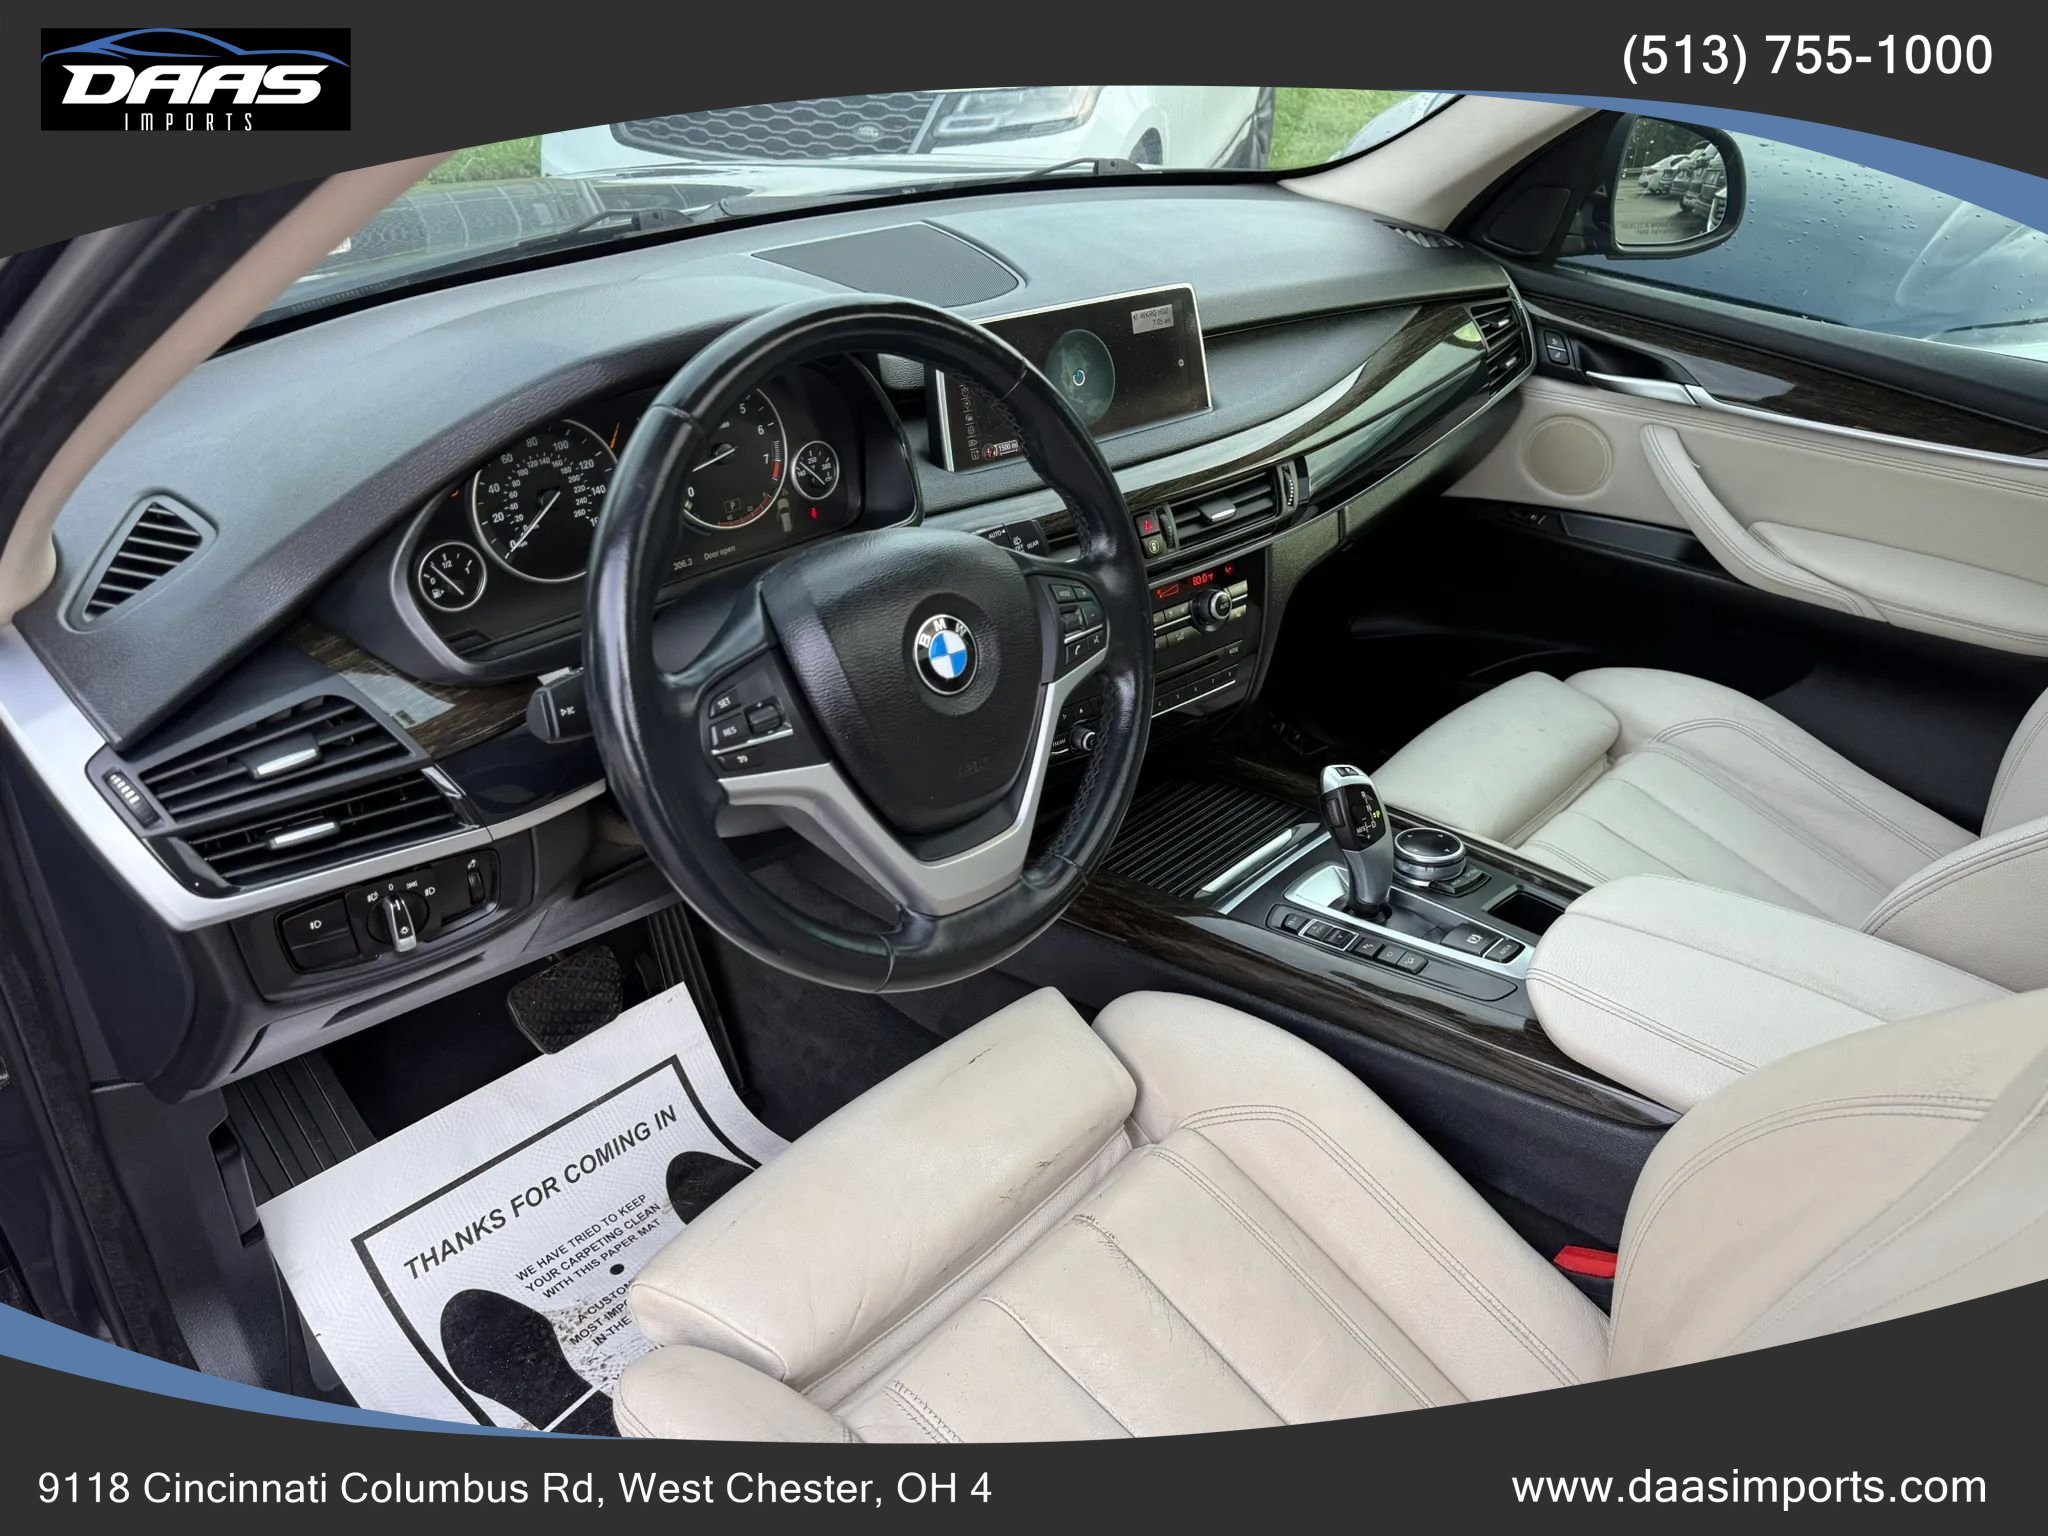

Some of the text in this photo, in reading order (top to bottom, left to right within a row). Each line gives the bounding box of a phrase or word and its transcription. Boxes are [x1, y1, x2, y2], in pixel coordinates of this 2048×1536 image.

[739, 403, 746, 414] 5
[757, 424, 765, 435] 6
[526, 436, 538, 447] 80
[553, 440, 569, 451] 100
[501, 453, 513, 464] 60
[527, 460, 539, 468] 120
[539, 457, 551, 465] 140
[552, 459, 563, 468] 160
[763, 454, 769, 465] 7
[560, 466, 572, 475] 180
[579, 459, 594, 471] 120
[517, 468, 529, 477] 100
[512, 479, 521, 487] 80
[568, 474, 580, 483] 200
[488, 483, 500, 494] 40
[509, 490, 518, 498] 60
[573, 485, 586, 494] 220
[591, 484, 606, 496] 140
[687, 486, 695, 497] 0
[509, 503, 519, 511] 40
[576, 497, 588, 506] 240
[492, 512, 505, 523] 20
[515, 514, 524, 522] 20
[573, 509, 586, 518] 260
[988, 530, 1002, 539] AUTO
[1026, 540, 1040, 550] REAR
[703, 545, 736, 560] Door open
[672, 558, 693, 571] 306.3
[919, 617, 967, 648] BMW
[722, 726, 737, 737] RES
[404, 1104, 678, 1279] THANKS FOR COMING IN
[515, 1194, 646, 1281] WE HAVE TRIED TO KEEP
[525, 1203, 661, 1293] YOUR CARPETING CLEAN
[542, 1218, 661, 1299] WITH THIS PAPER MAT
[577, 1314, 588, 1323] A
[569, 1318, 604, 1345] MOST
[592, 1315, 632, 1346] IN THE
